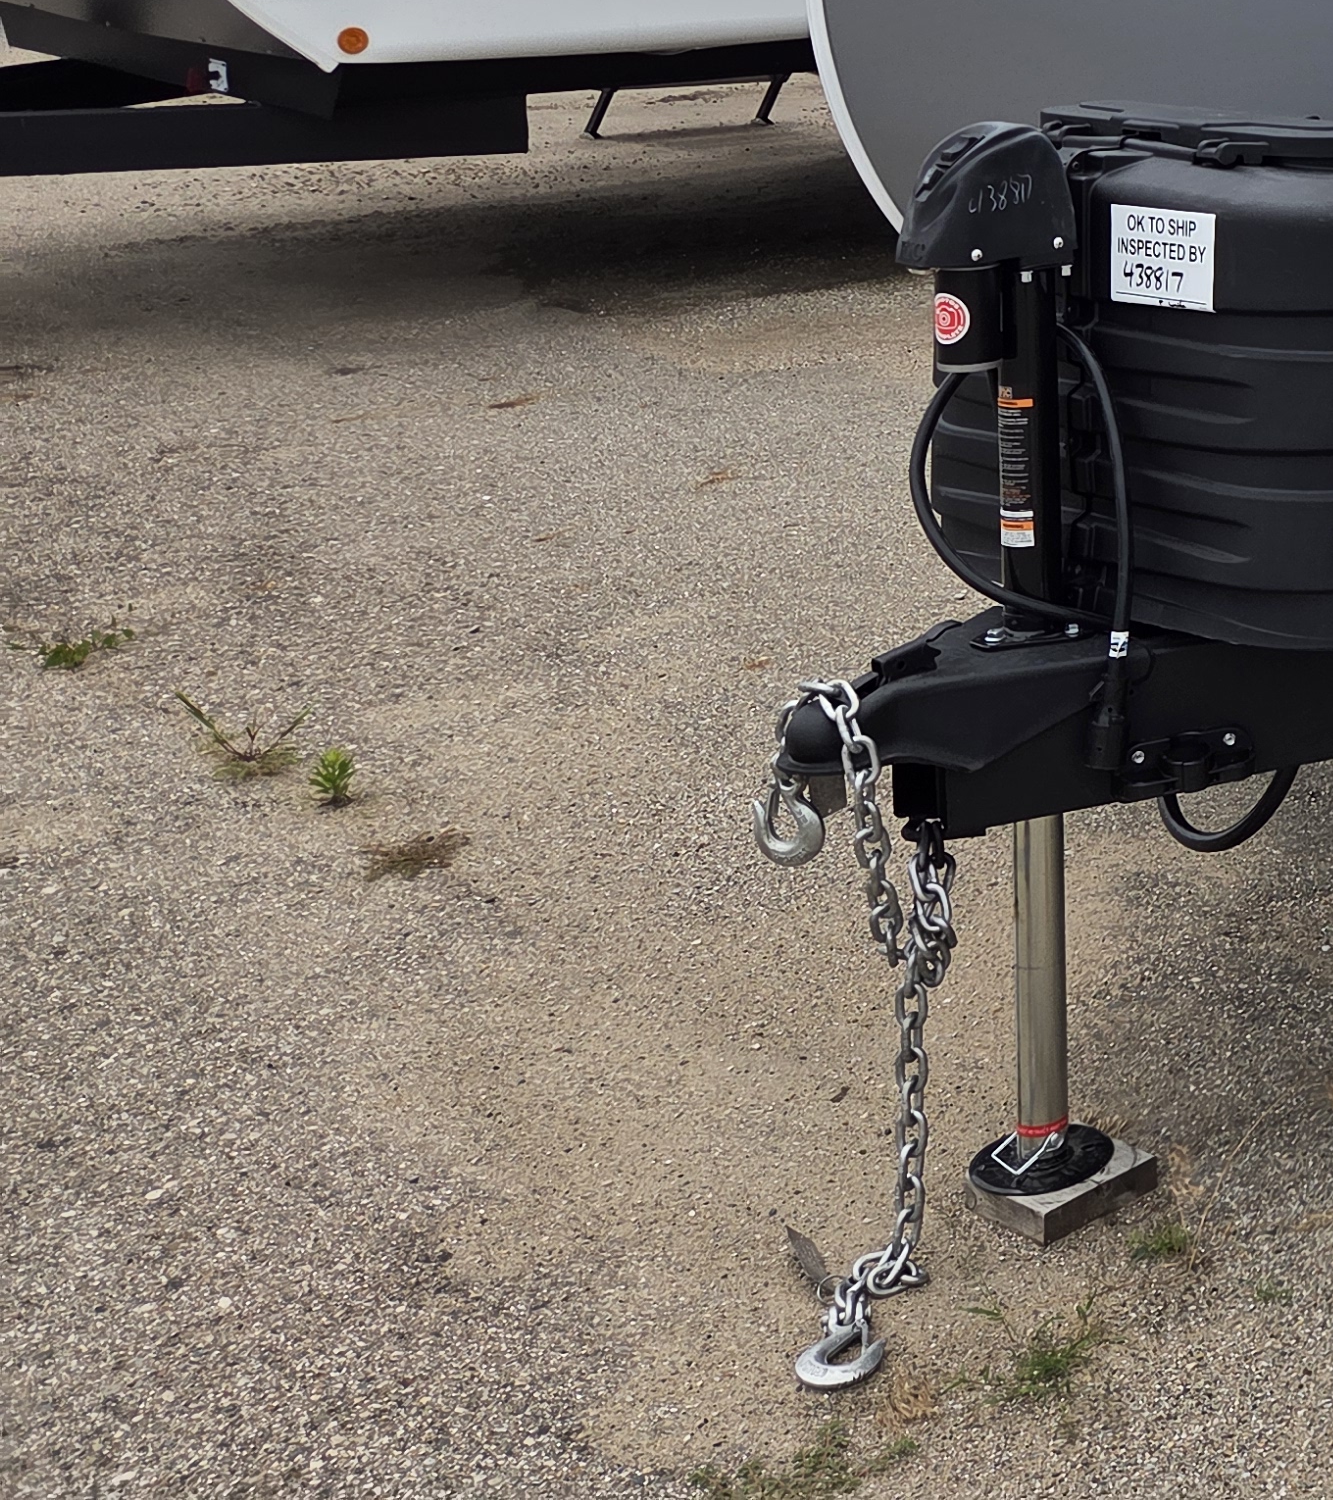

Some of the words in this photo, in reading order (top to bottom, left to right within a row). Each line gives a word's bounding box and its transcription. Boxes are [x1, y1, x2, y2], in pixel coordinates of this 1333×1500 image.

[1126, 214, 1145, 232] OK
[1148, 216, 1165, 234] TO
[1168, 218, 1197, 238] SHIP
[1117, 237, 1186, 261] INSPECTED
[1189, 245, 1207, 264] BY
[1123, 260, 1184, 293] 438817
